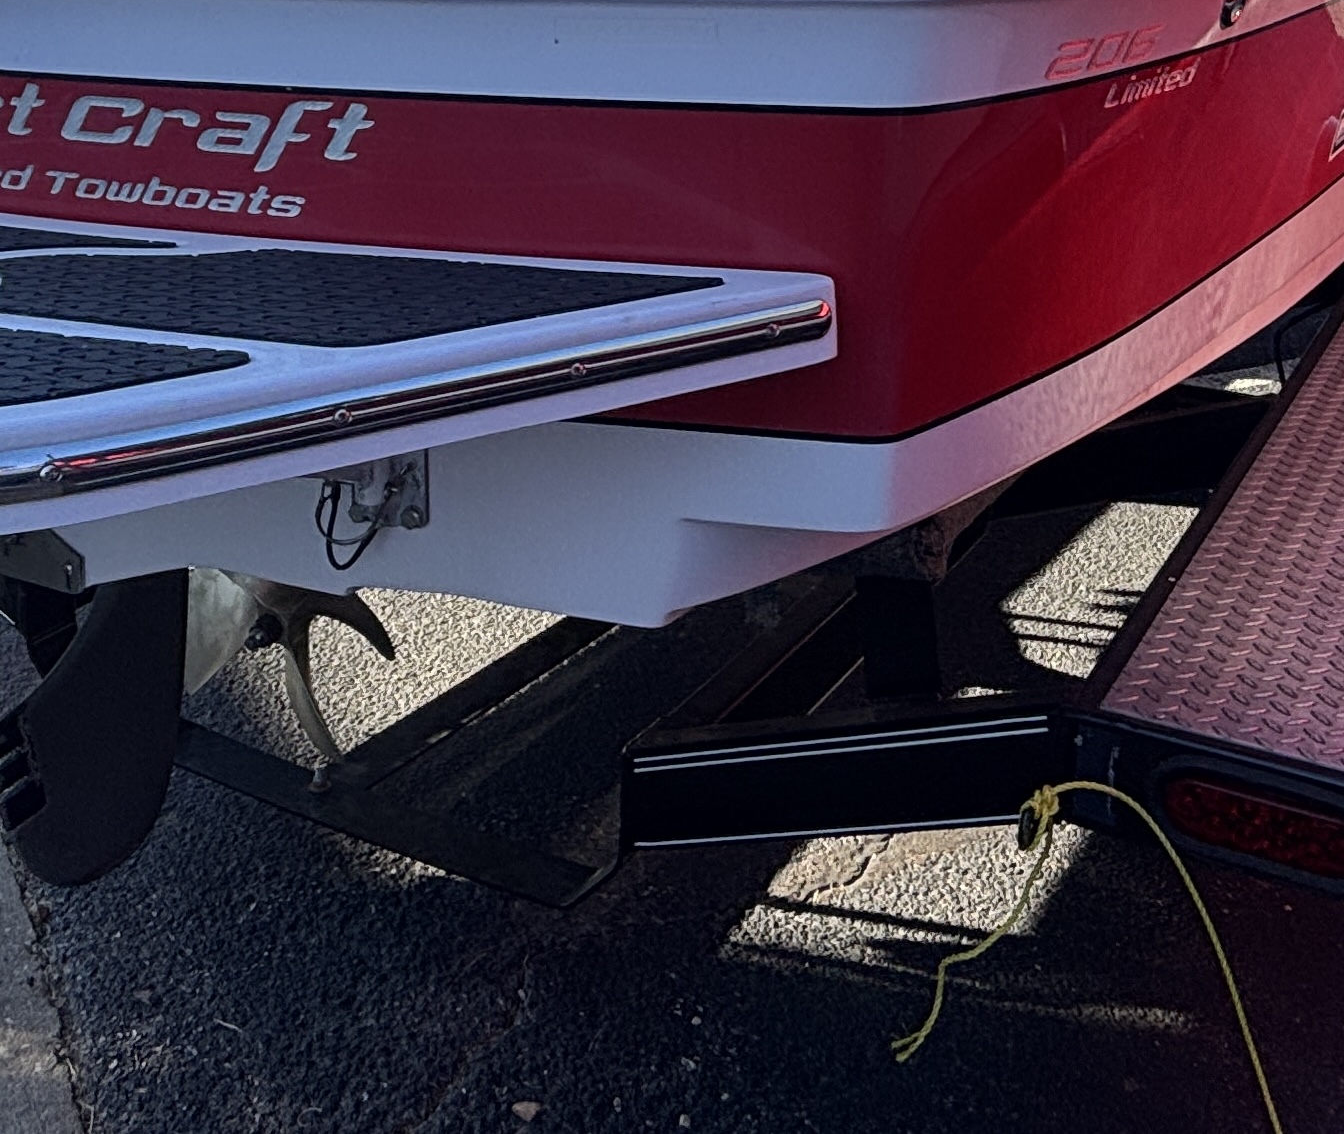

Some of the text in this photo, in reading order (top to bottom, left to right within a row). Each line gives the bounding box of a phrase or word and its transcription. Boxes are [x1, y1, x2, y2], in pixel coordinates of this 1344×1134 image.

[1044, 24, 1164, 80] 206
[1103, 56, 1201, 108] Limited
[60, 95, 376, 173] Craft
[45, 170, 306, 218] Towboats
